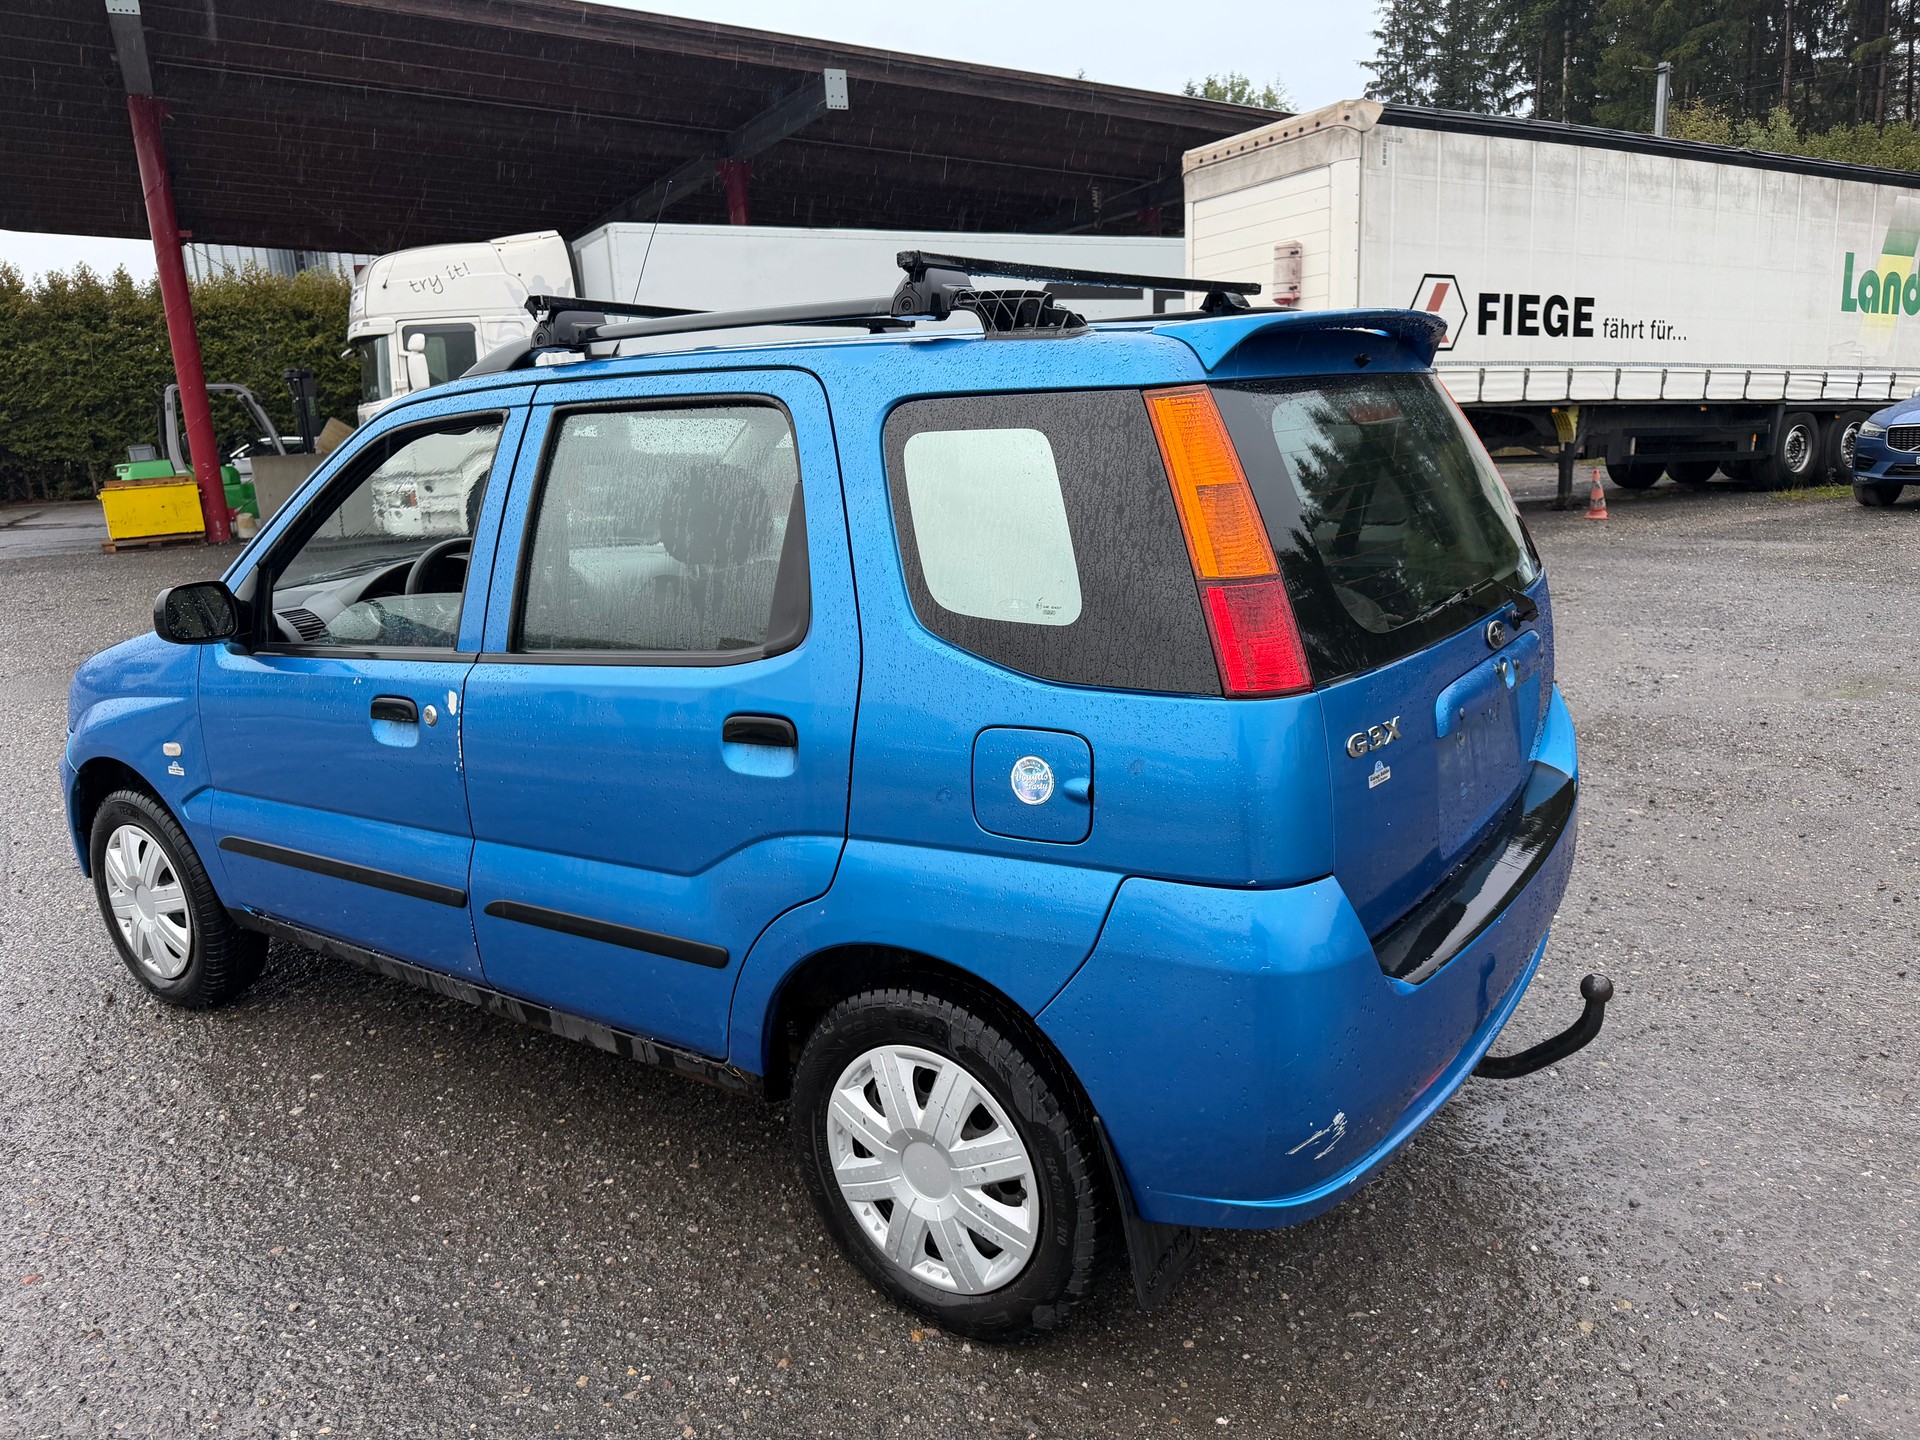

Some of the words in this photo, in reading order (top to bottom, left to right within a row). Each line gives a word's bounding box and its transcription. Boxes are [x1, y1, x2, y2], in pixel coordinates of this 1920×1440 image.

[409, 273, 444, 294] try
[446, 262, 471, 280] it!
[1477, 292, 1595, 338] FIEGE
[1602, 318, 1645, 340] fährt
[1650, 318, 1688, 341] für...
[1346, 715, 1402, 759] G3X
